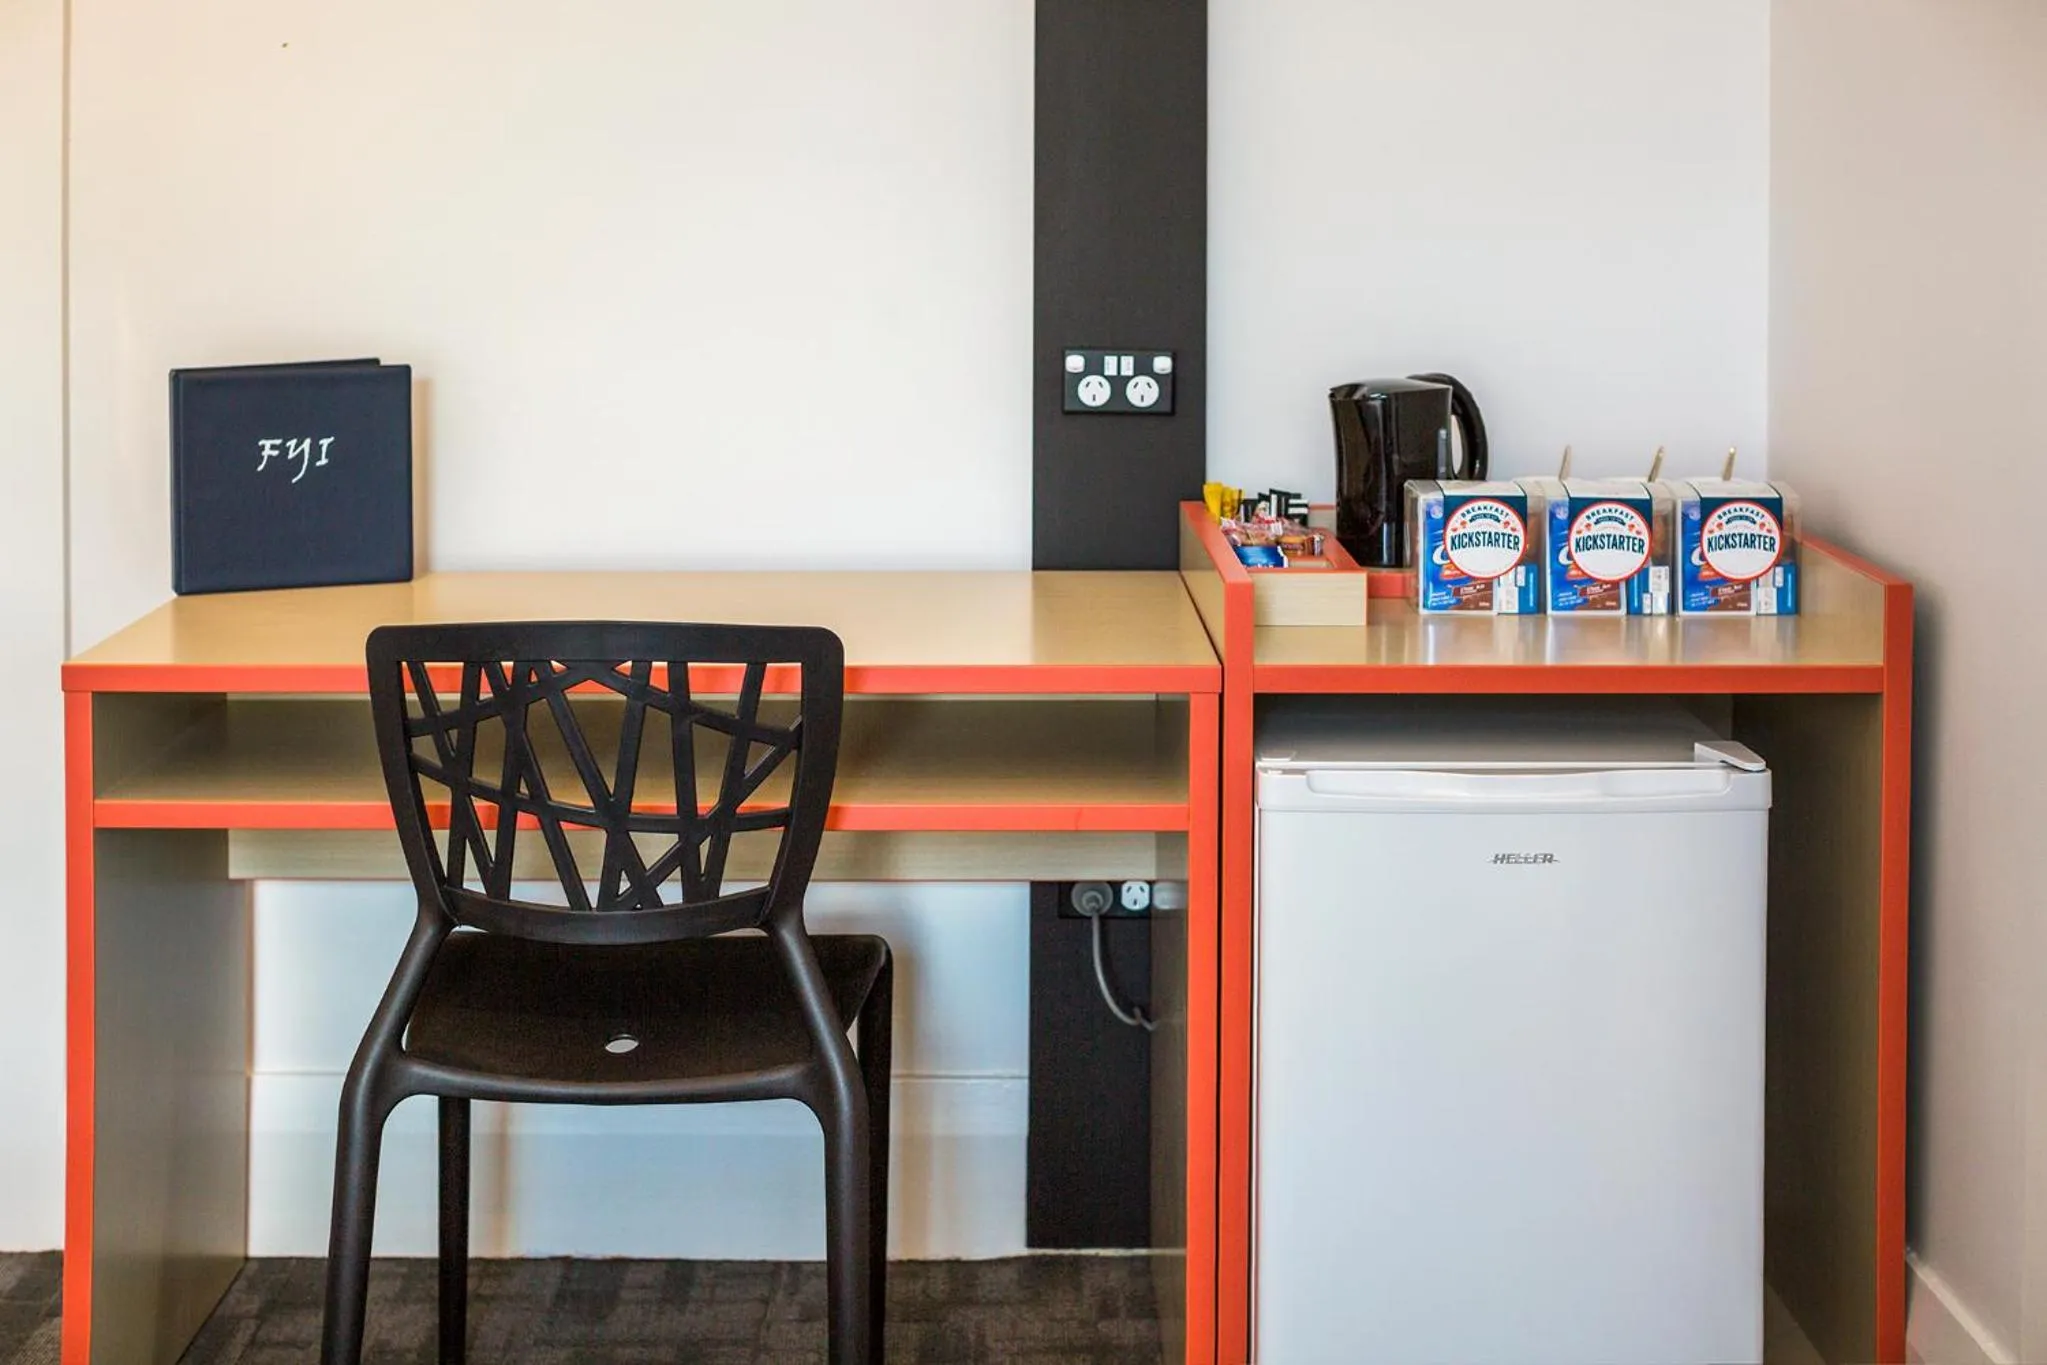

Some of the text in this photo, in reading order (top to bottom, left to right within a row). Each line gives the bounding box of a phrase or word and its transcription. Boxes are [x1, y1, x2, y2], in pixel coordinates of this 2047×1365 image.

[256, 436, 335, 484] FYI
[1461, 504, 1510, 518] BREAKFAST
[1585, 507, 1635, 520] BREAKFAST
[1717, 507, 1765, 520] BREAKFAST
[1450, 530, 1520, 552] KICKSTARTER
[1574, 533, 1646, 555] KICKSTARTER
[1707, 532, 1776, 553] KICKSTARTER
[1492, 853, 1557, 865] HELLER
